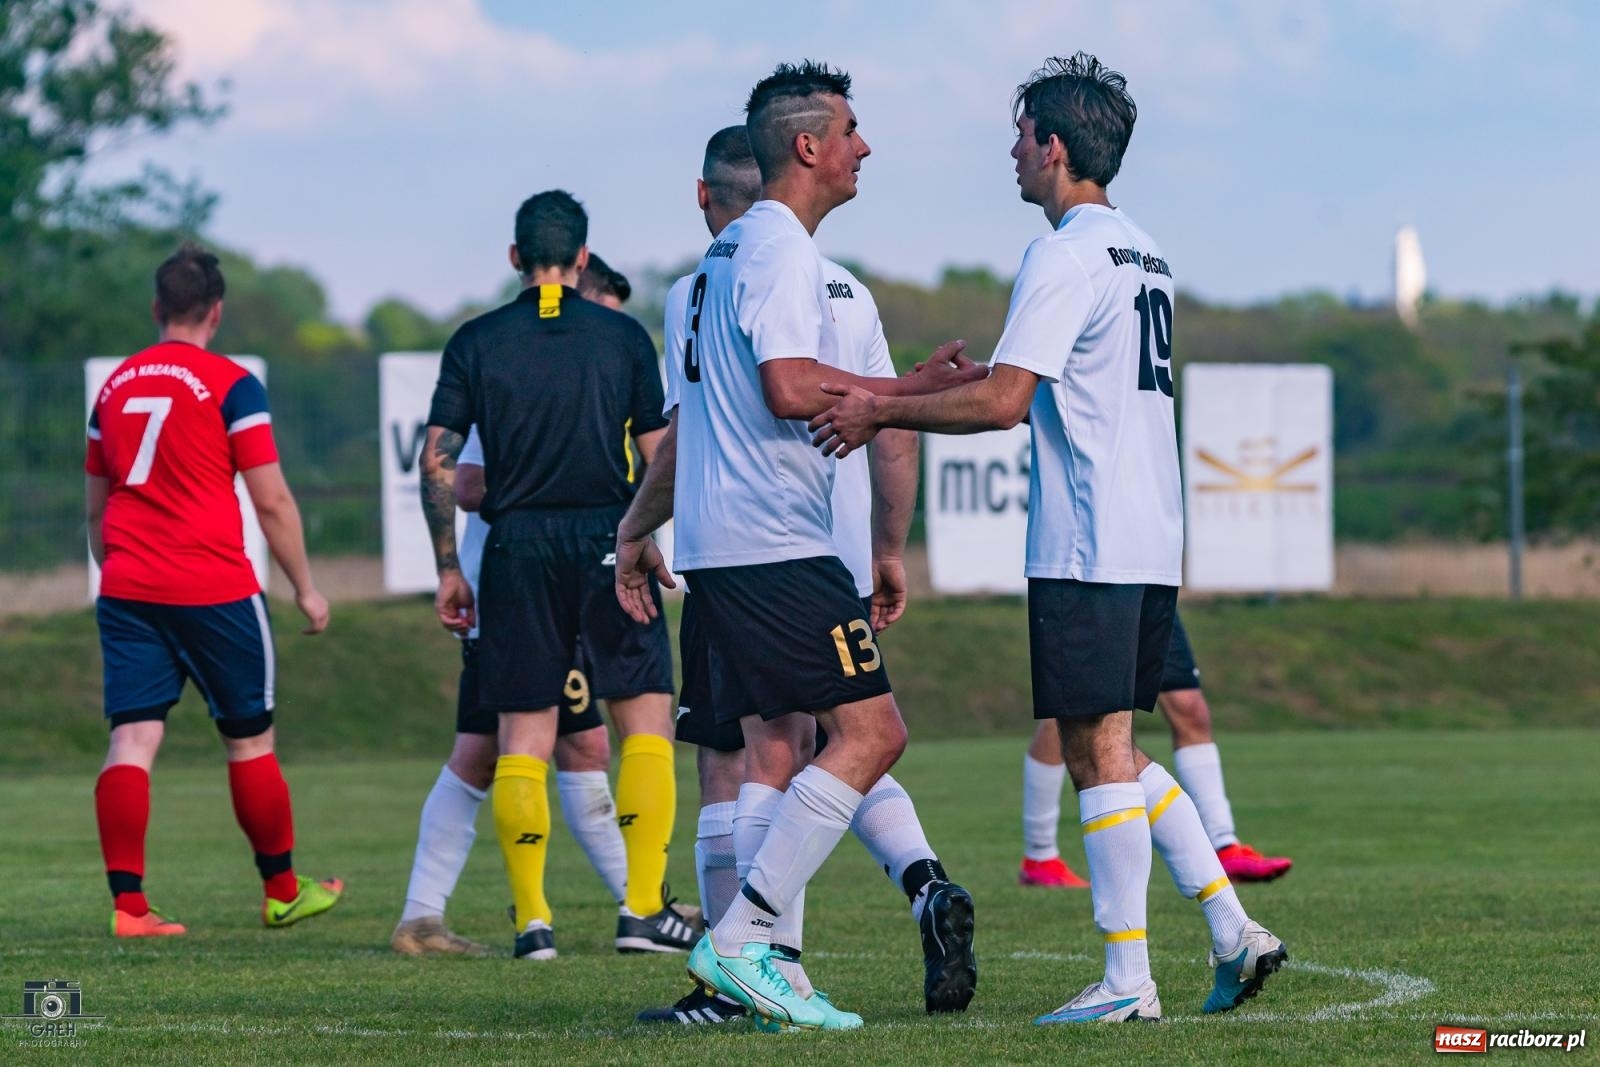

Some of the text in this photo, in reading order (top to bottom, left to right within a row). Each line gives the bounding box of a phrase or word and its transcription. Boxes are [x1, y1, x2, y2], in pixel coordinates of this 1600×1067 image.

[826, 279, 854, 299] nica
[1134, 283, 1174, 398] 19
[121, 396, 174, 486] 7
[830, 618, 882, 678] 13
[563, 669, 590, 715] 9
